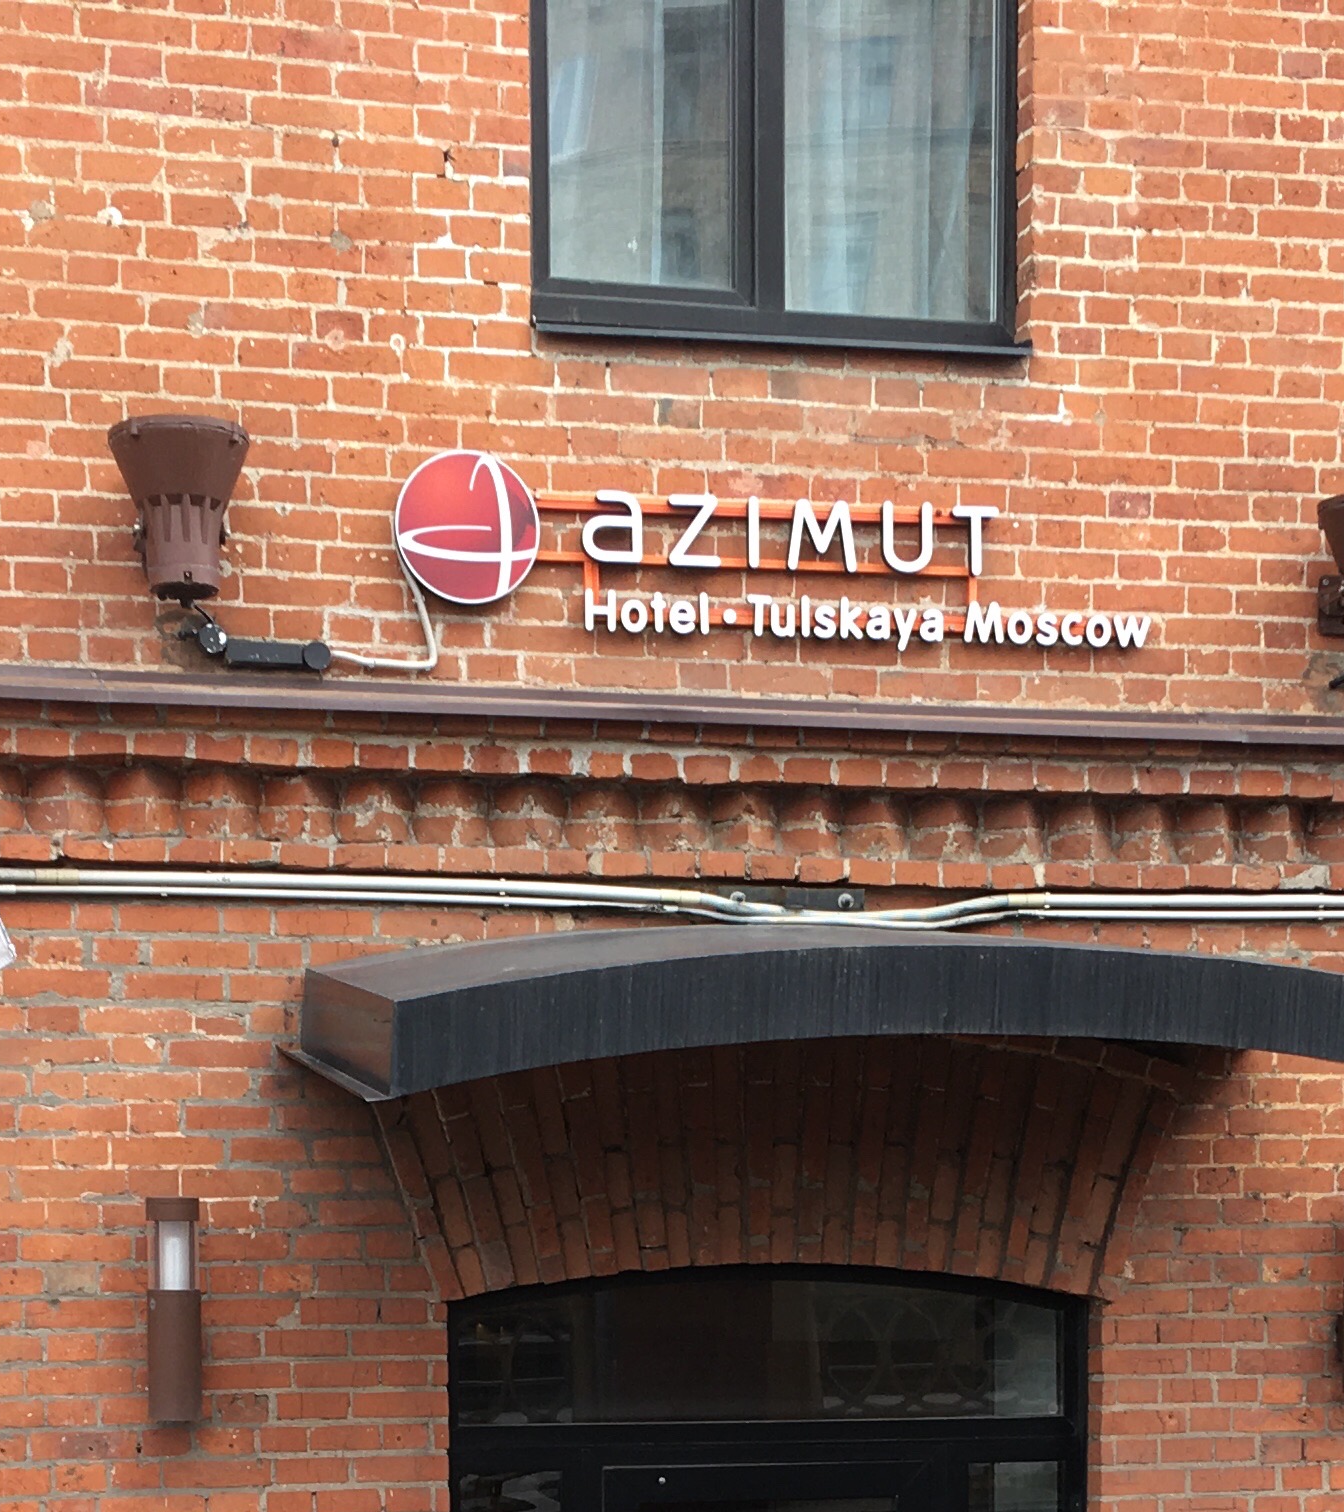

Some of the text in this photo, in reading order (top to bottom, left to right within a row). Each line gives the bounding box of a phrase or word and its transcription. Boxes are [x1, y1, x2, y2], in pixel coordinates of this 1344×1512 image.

[583, 588, 1154, 652] Hotel Tulskaya Moscow
